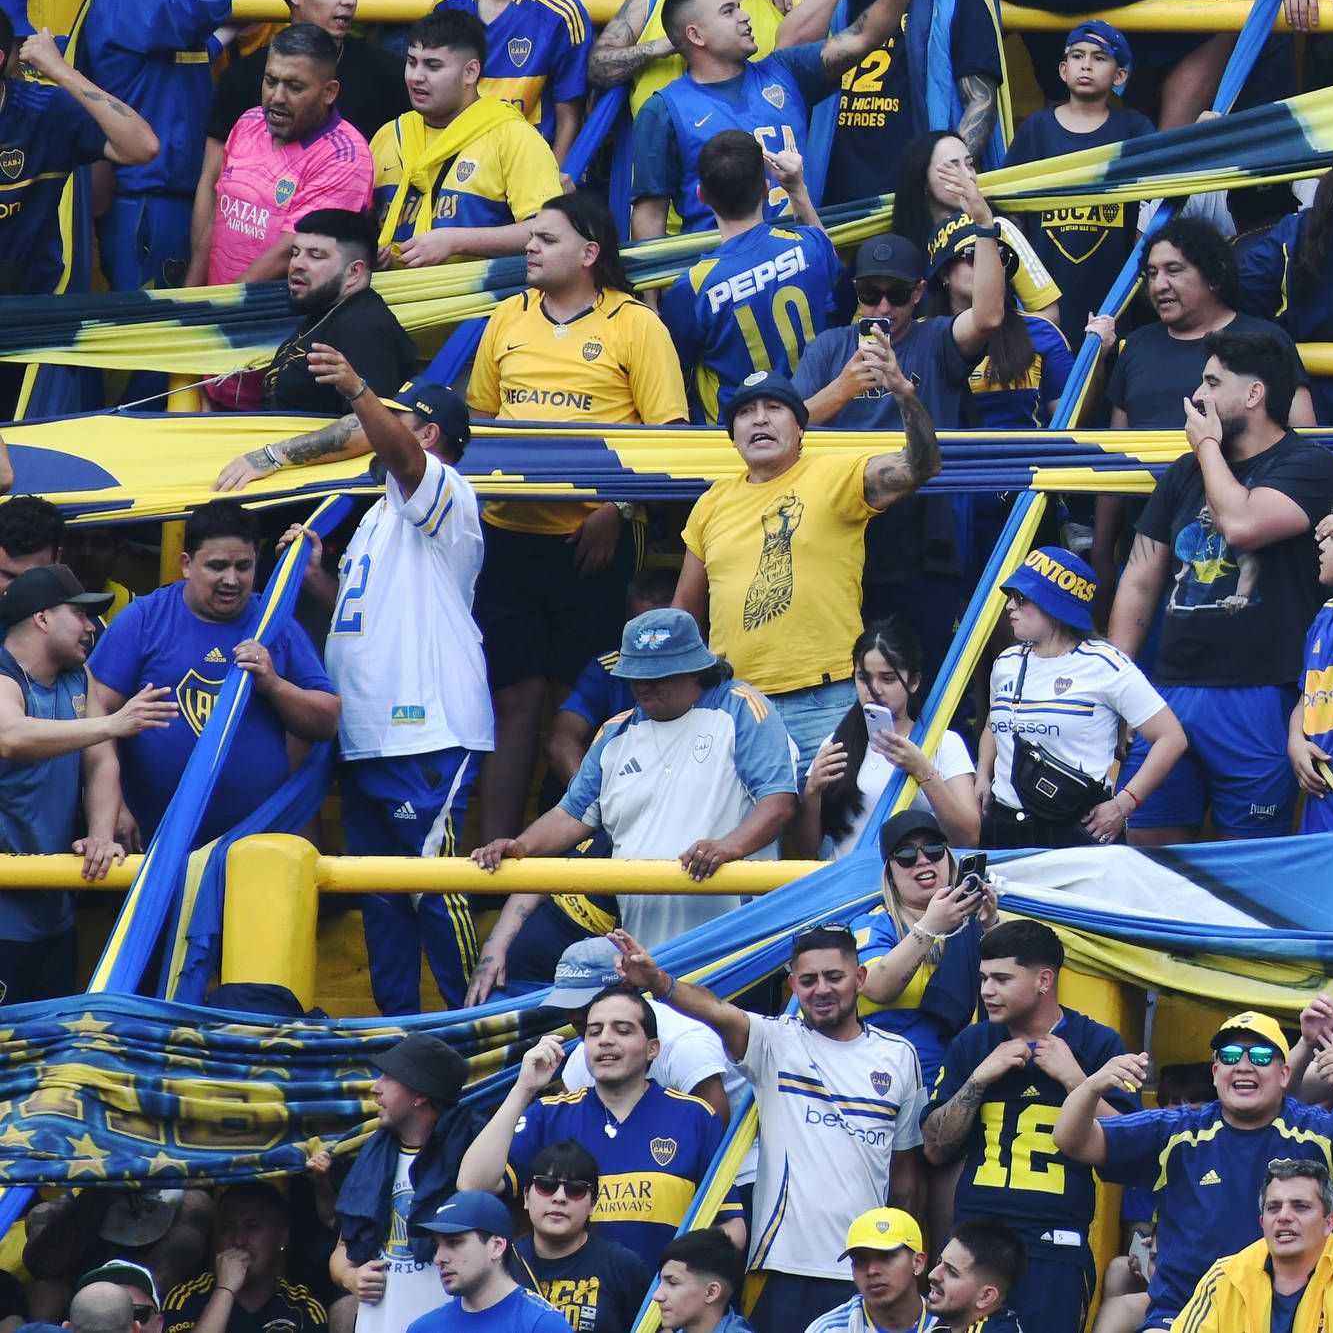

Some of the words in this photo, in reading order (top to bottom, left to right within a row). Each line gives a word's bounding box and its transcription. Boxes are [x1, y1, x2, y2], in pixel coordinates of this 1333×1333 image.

[851, 96, 901, 112] HICIMOS
[839, 112, 886, 127] STADES
[3, 157, 22, 167] CABJ
[221, 196, 269, 228] QATAR
[227, 217, 266, 242] AIRWAYS
[706, 246, 808, 314] PEPSI
[735, 286, 816, 373] 10
[416, 402, 433, 415] CABJ
[1026, 549, 1096, 603] UNIORS
[205, 655, 226, 664] adidas
[395, 811, 417, 820] adidas
[1249, 804, 1278, 816] EVERLAST
[872, 1077, 890, 1085] CABJ
[653, 1147, 675, 1155] CABJ
[973, 1102, 1067, 1195] 12
[598, 1179, 652, 1201] ATAR
